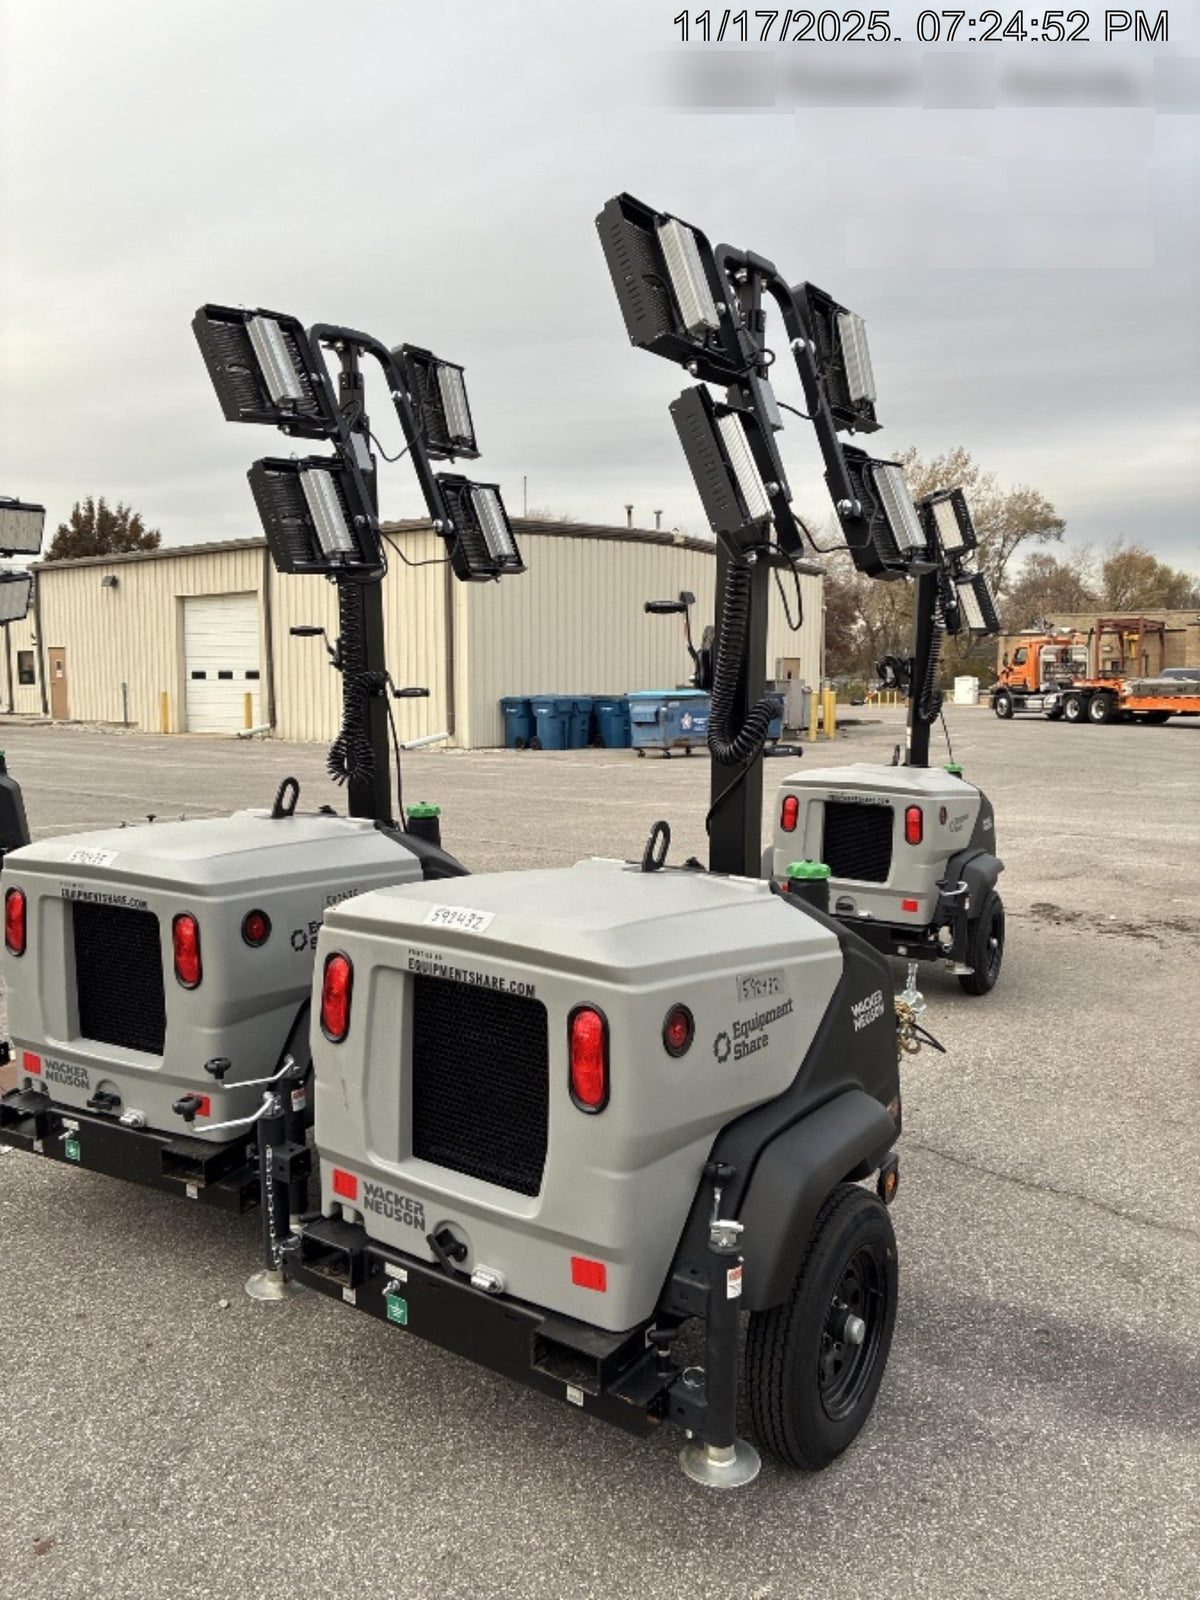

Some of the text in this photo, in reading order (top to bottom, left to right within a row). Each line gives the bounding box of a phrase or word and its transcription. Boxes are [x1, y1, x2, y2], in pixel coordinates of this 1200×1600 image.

[408, 957, 536, 998] EQUIPMENTSHARE.COM
[732, 998, 794, 1040] Equipment
[851, 989, 883, 1017] WACKER
[733, 1033, 769, 1061] Share
[44, 1059, 89, 1080] WACKER
[45, 1070, 90, 1090] NEUSON
[363, 1181, 425, 1217] WACKER
[363, 1196, 426, 1232] NEUSON
